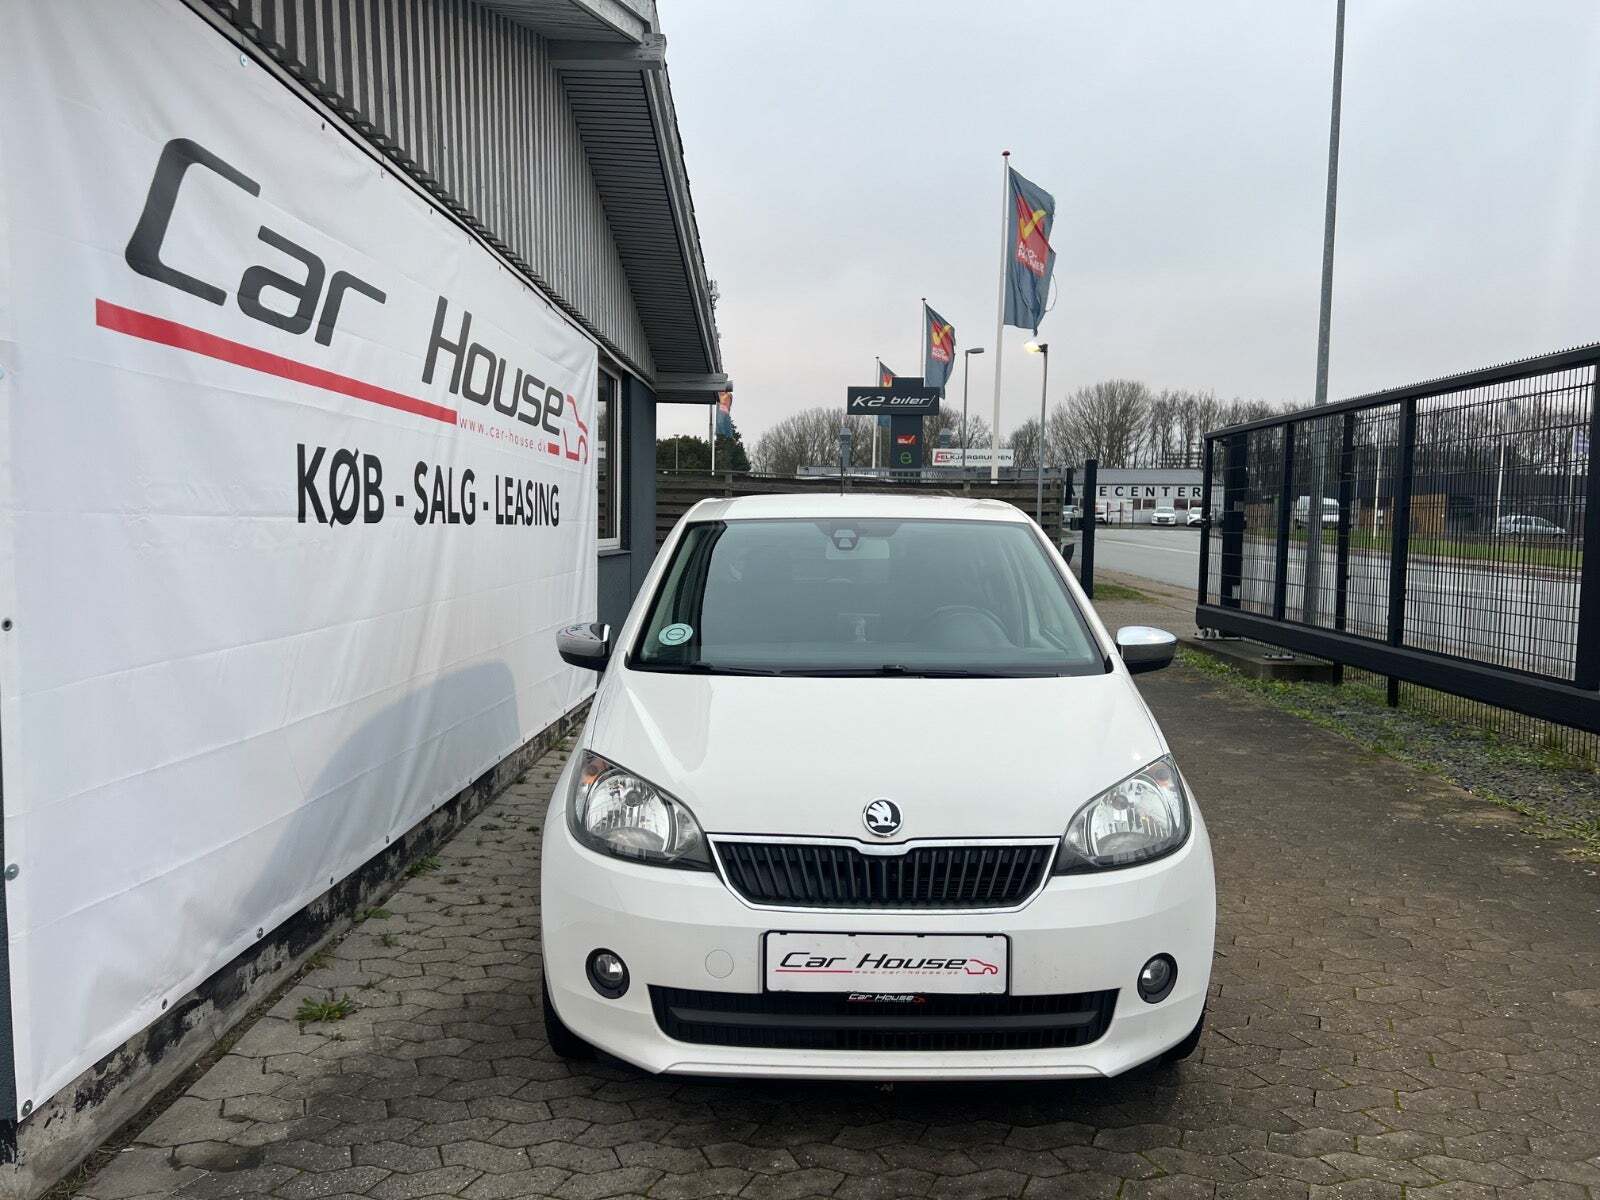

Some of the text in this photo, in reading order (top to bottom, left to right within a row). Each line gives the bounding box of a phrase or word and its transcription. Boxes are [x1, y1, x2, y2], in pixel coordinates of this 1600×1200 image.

[125, 138, 565, 436] Car House
[852, 395, 930, 407] K2 biler
[297, 443, 384, 528] KØB
[414, 461, 476, 525] SALG
[495, 474, 560, 527] LEASING
[1066, 486, 1201, 497] ECENTER
[780, 952, 968, 969] Car House
[874, 993, 914, 1001] House
